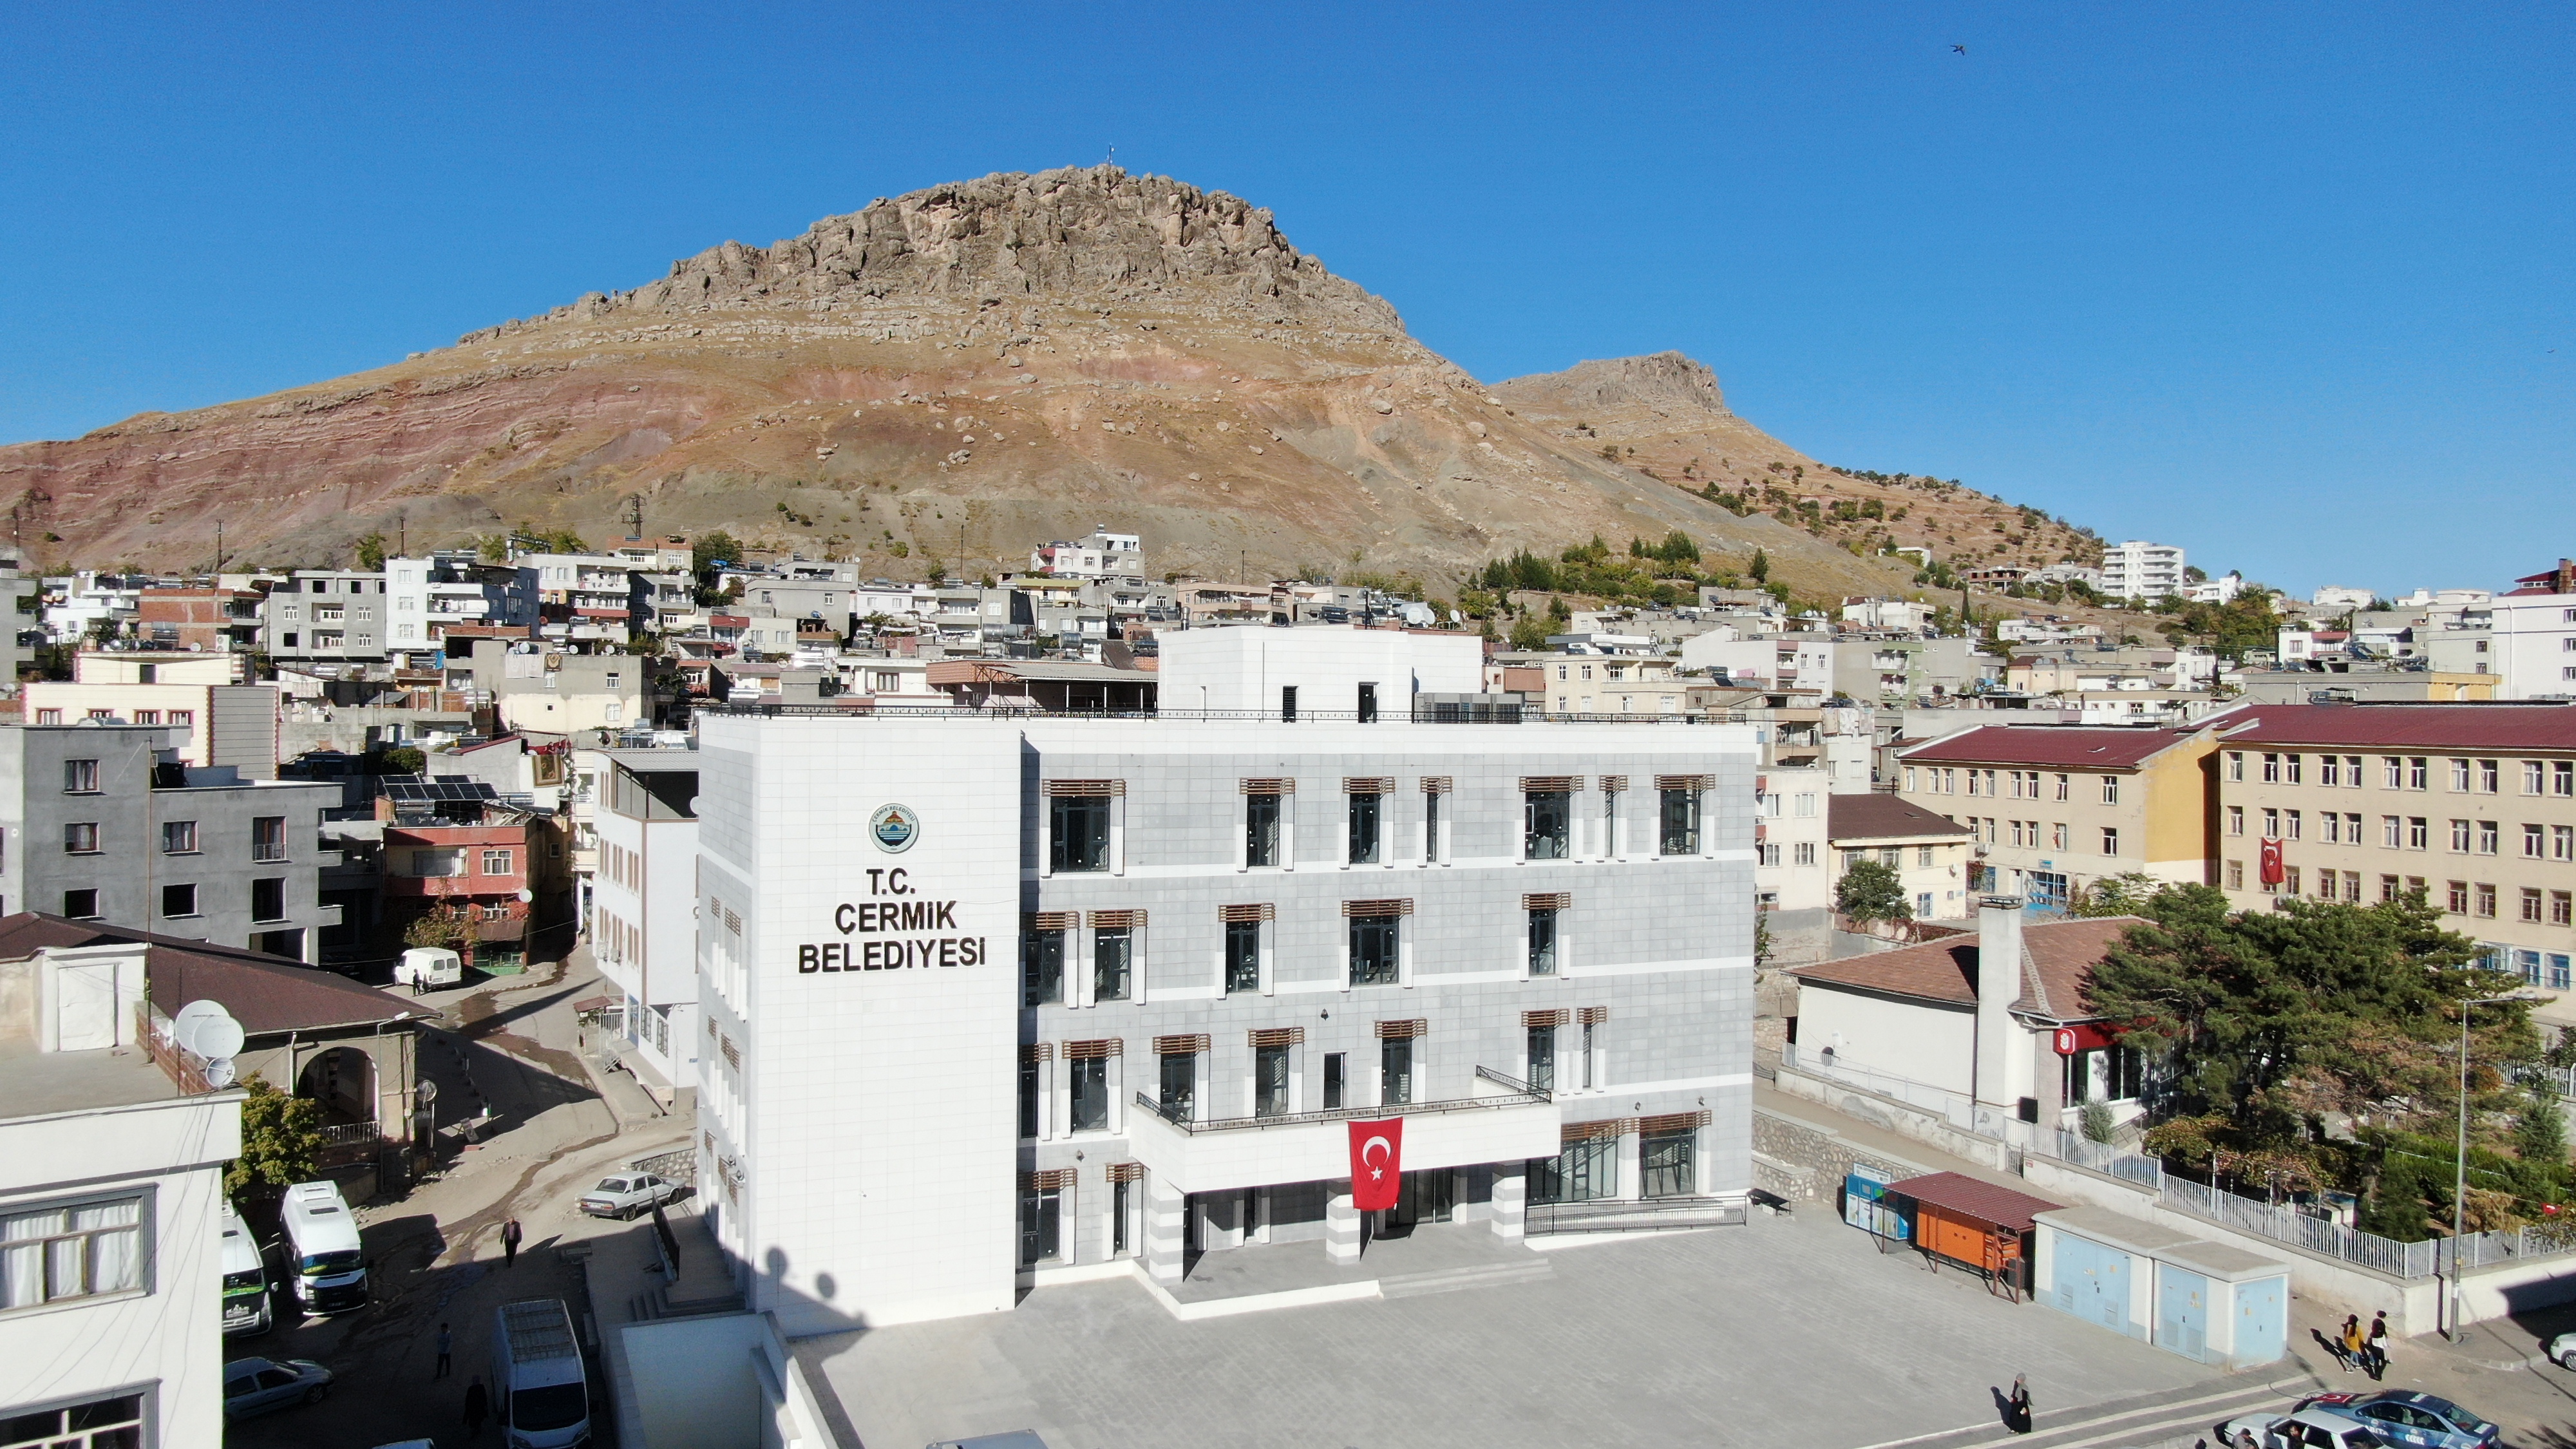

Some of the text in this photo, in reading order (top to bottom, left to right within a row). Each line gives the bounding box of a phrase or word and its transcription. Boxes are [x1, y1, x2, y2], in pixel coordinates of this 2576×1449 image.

[889, 806, 915, 822] BELEDİYESİ
[866, 867, 915, 895] T.C.
[835, 900, 957, 934] ÇERMİK
[799, 937, 985, 973] BELEDİYESİ
[2364, 1425, 2389, 1436] ABITA
